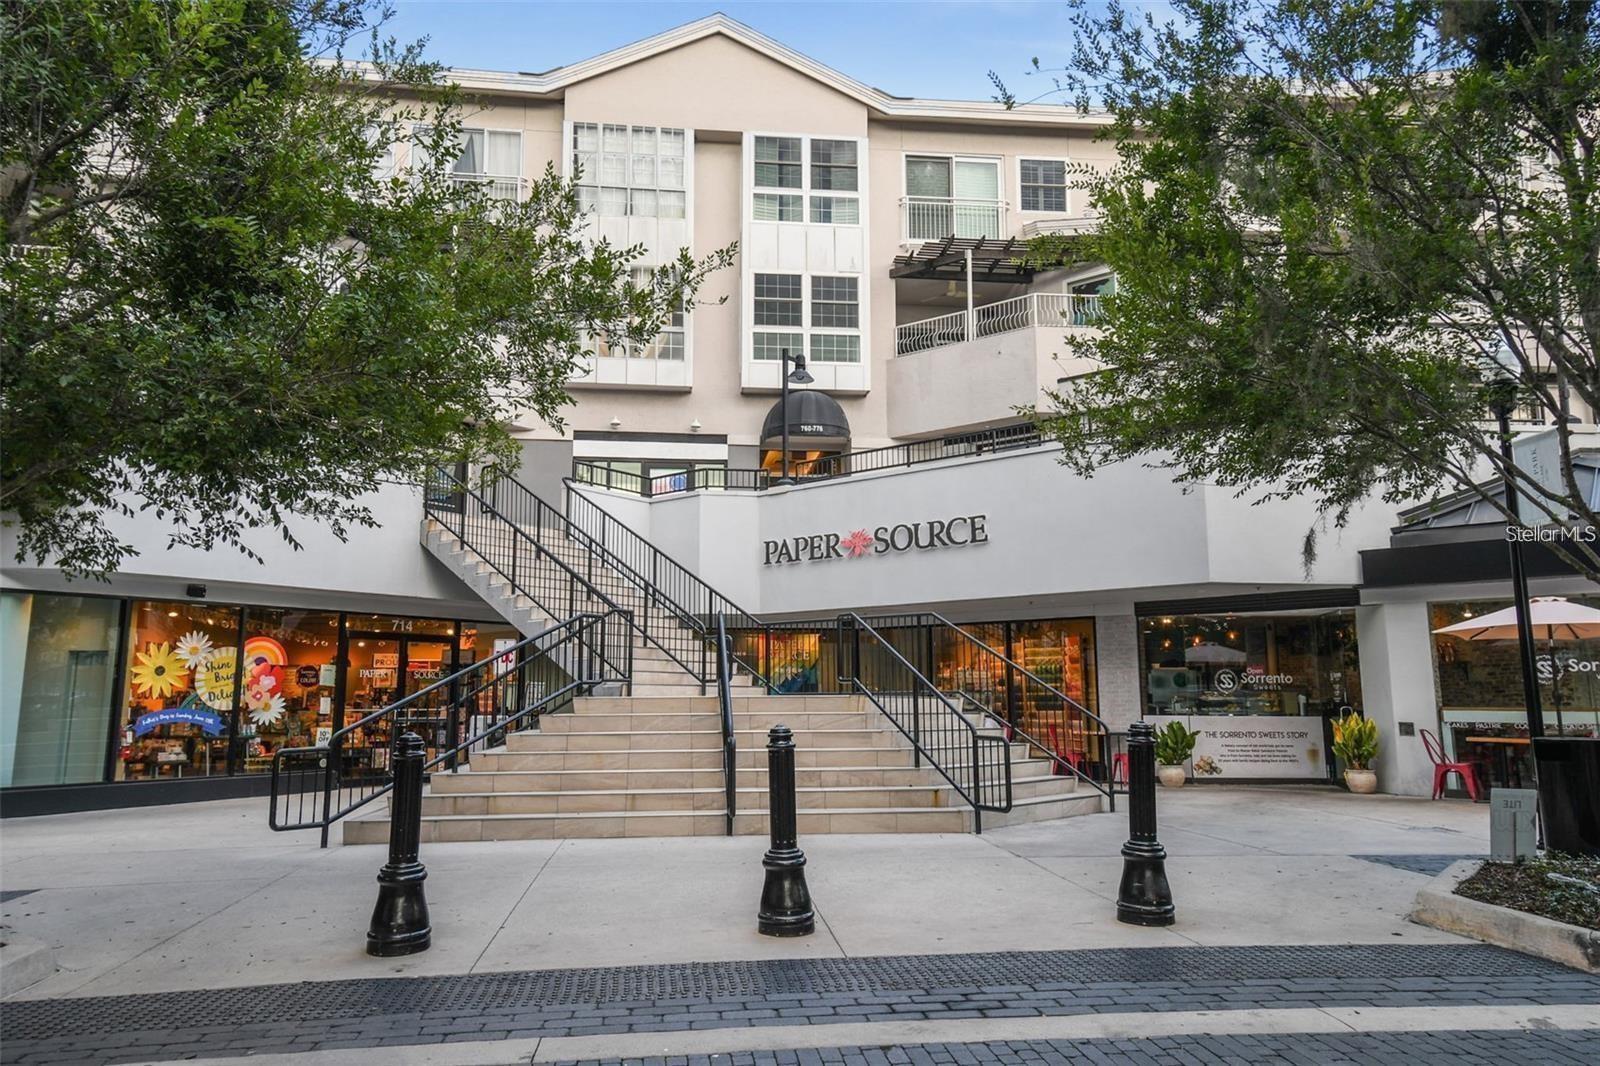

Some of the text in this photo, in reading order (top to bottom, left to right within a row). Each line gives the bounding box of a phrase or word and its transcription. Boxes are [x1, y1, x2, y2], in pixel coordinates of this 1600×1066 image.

[763, 514, 988, 565] PAPER SOURCE
[392, 620, 413, 632] 714
[205, 660, 232, 672] Shine
[413, 670, 444, 679] SOURCE
[1241, 673, 1293, 684] Sorrento
[1204, 731, 1309, 739] THE SORRENTO SWEETS STORY
